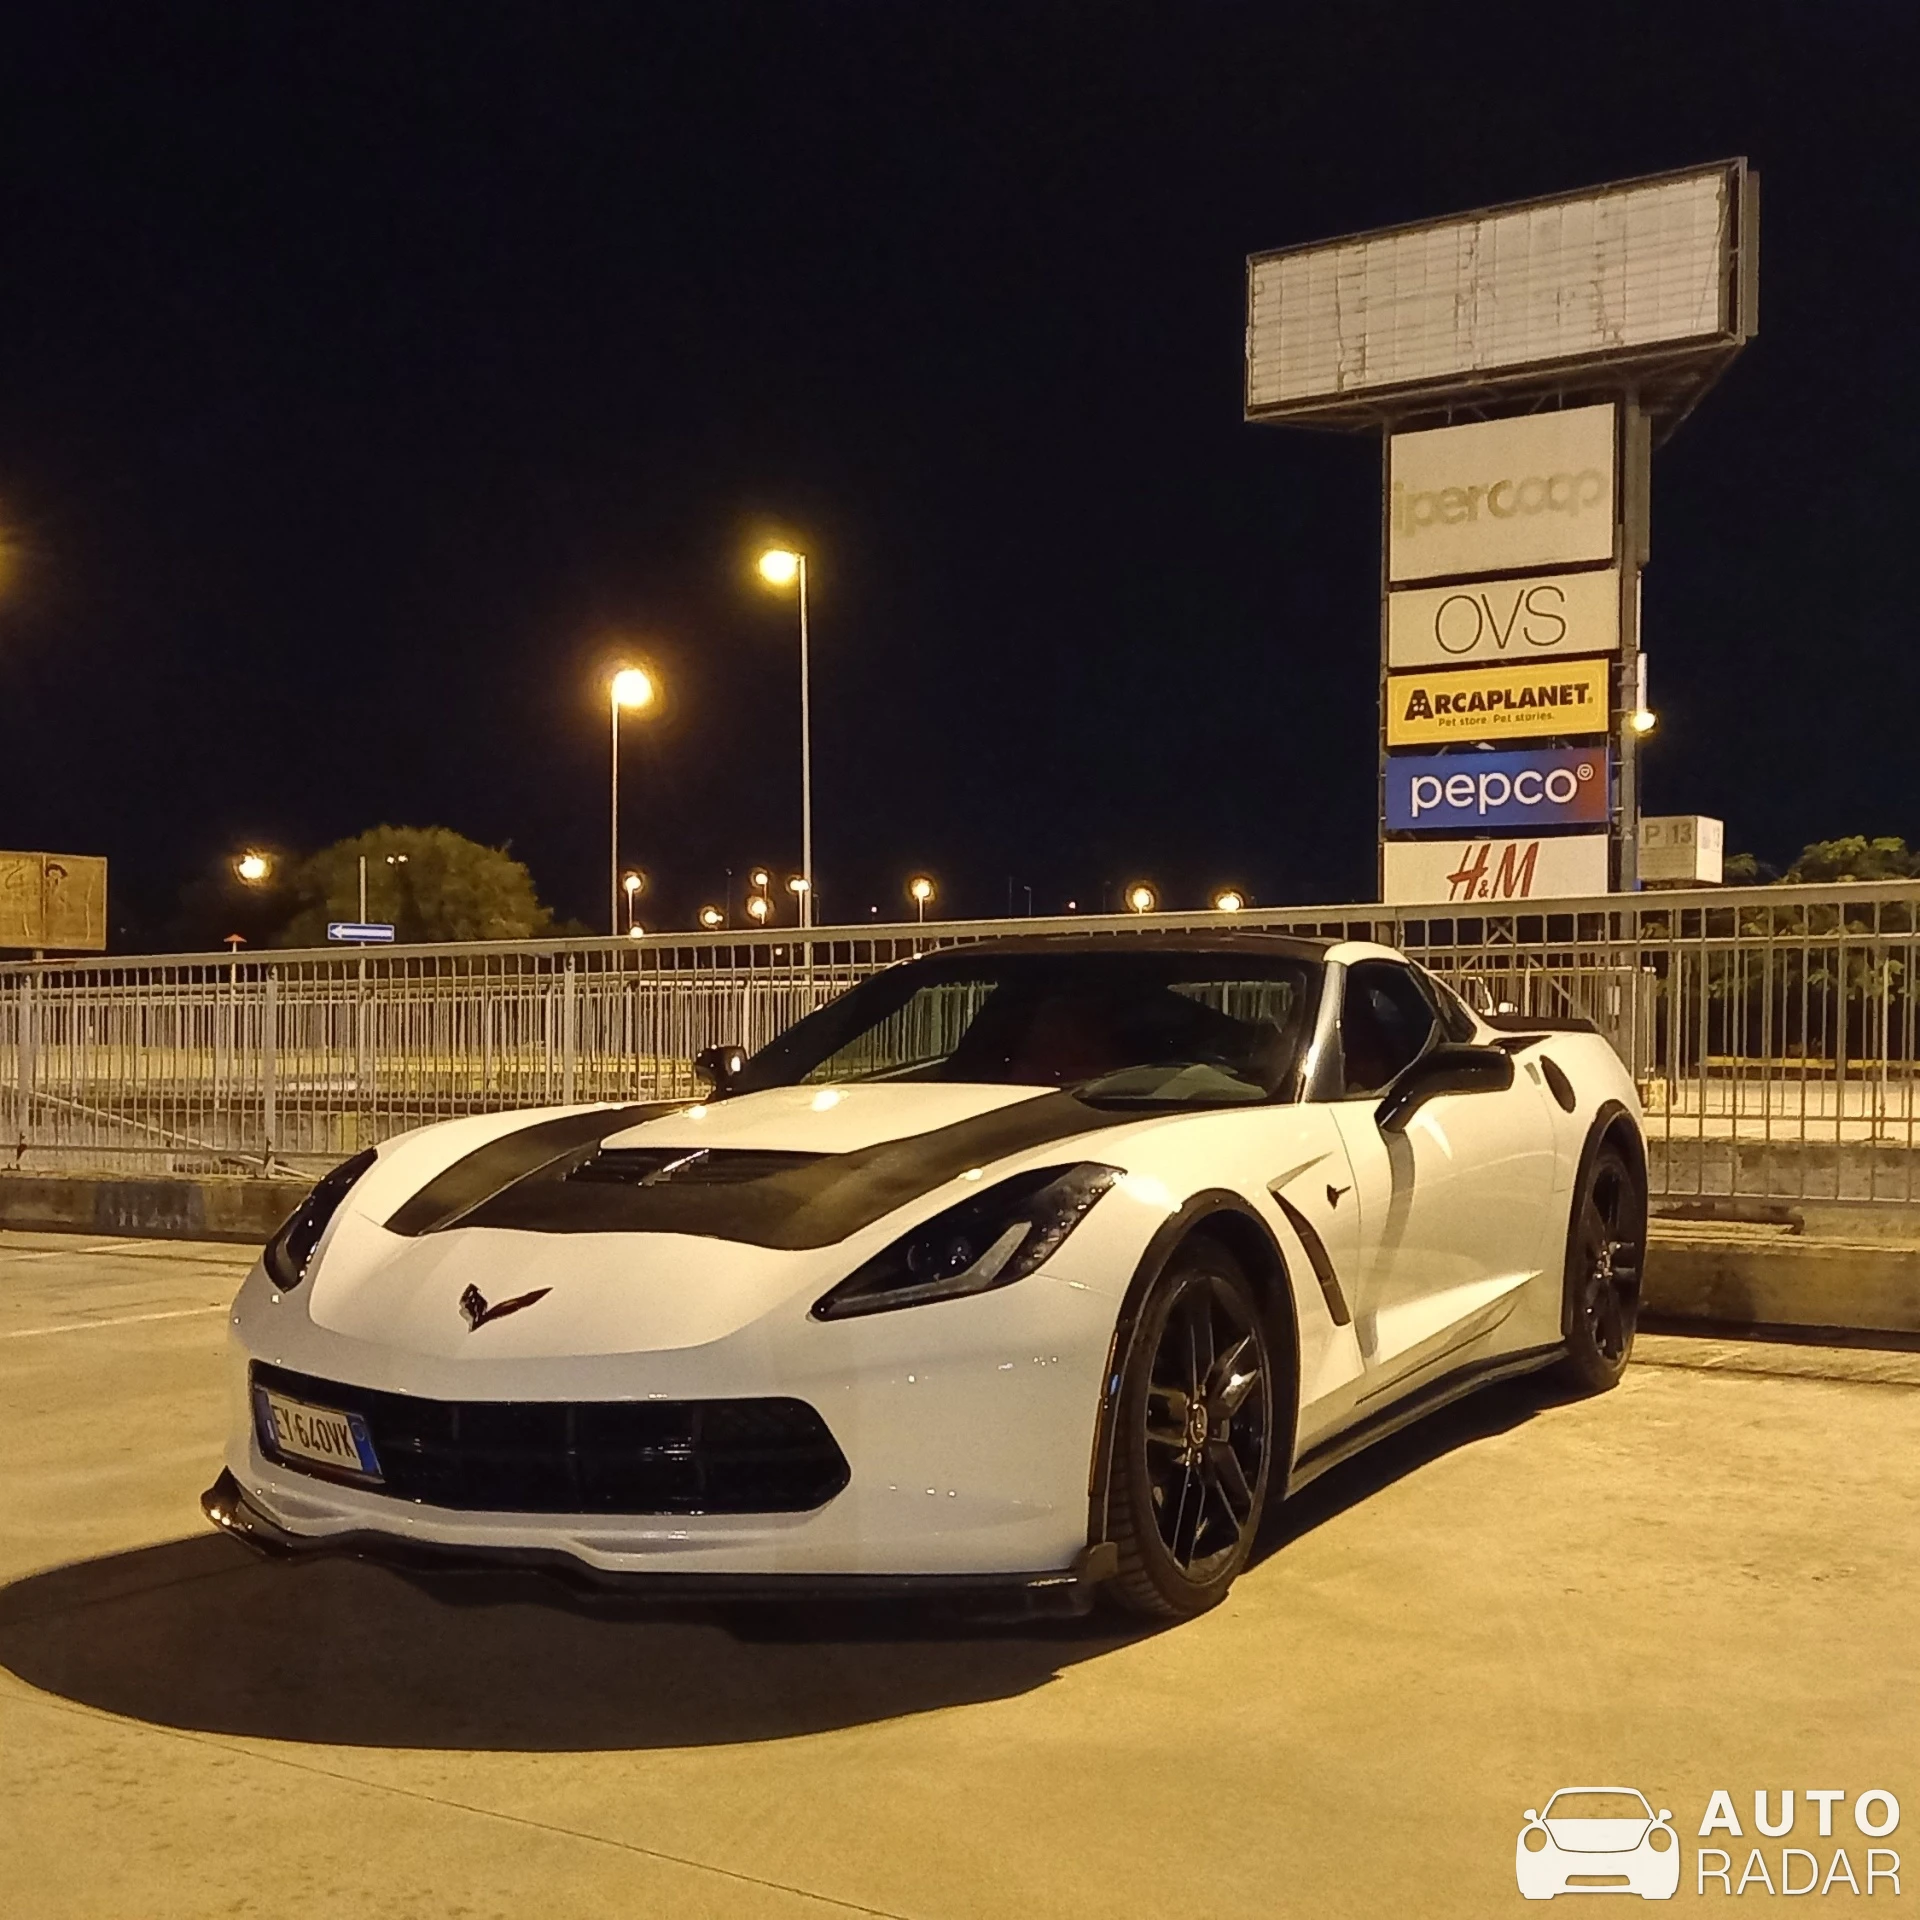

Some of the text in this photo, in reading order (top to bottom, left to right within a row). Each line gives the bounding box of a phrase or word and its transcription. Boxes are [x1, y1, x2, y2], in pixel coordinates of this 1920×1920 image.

[1434, 585, 1567, 654] OVS
[1404, 682, 1590, 721] ARCAPLANET
[1438, 715, 1457, 728] Pet
[1493, 711, 1513, 724] Pet
[1411, 767, 1578, 818] pepco
[1645, 824, 1660, 845] P
[1672, 822, 1692, 844] 13
[1446, 842, 1540, 901] H&M
